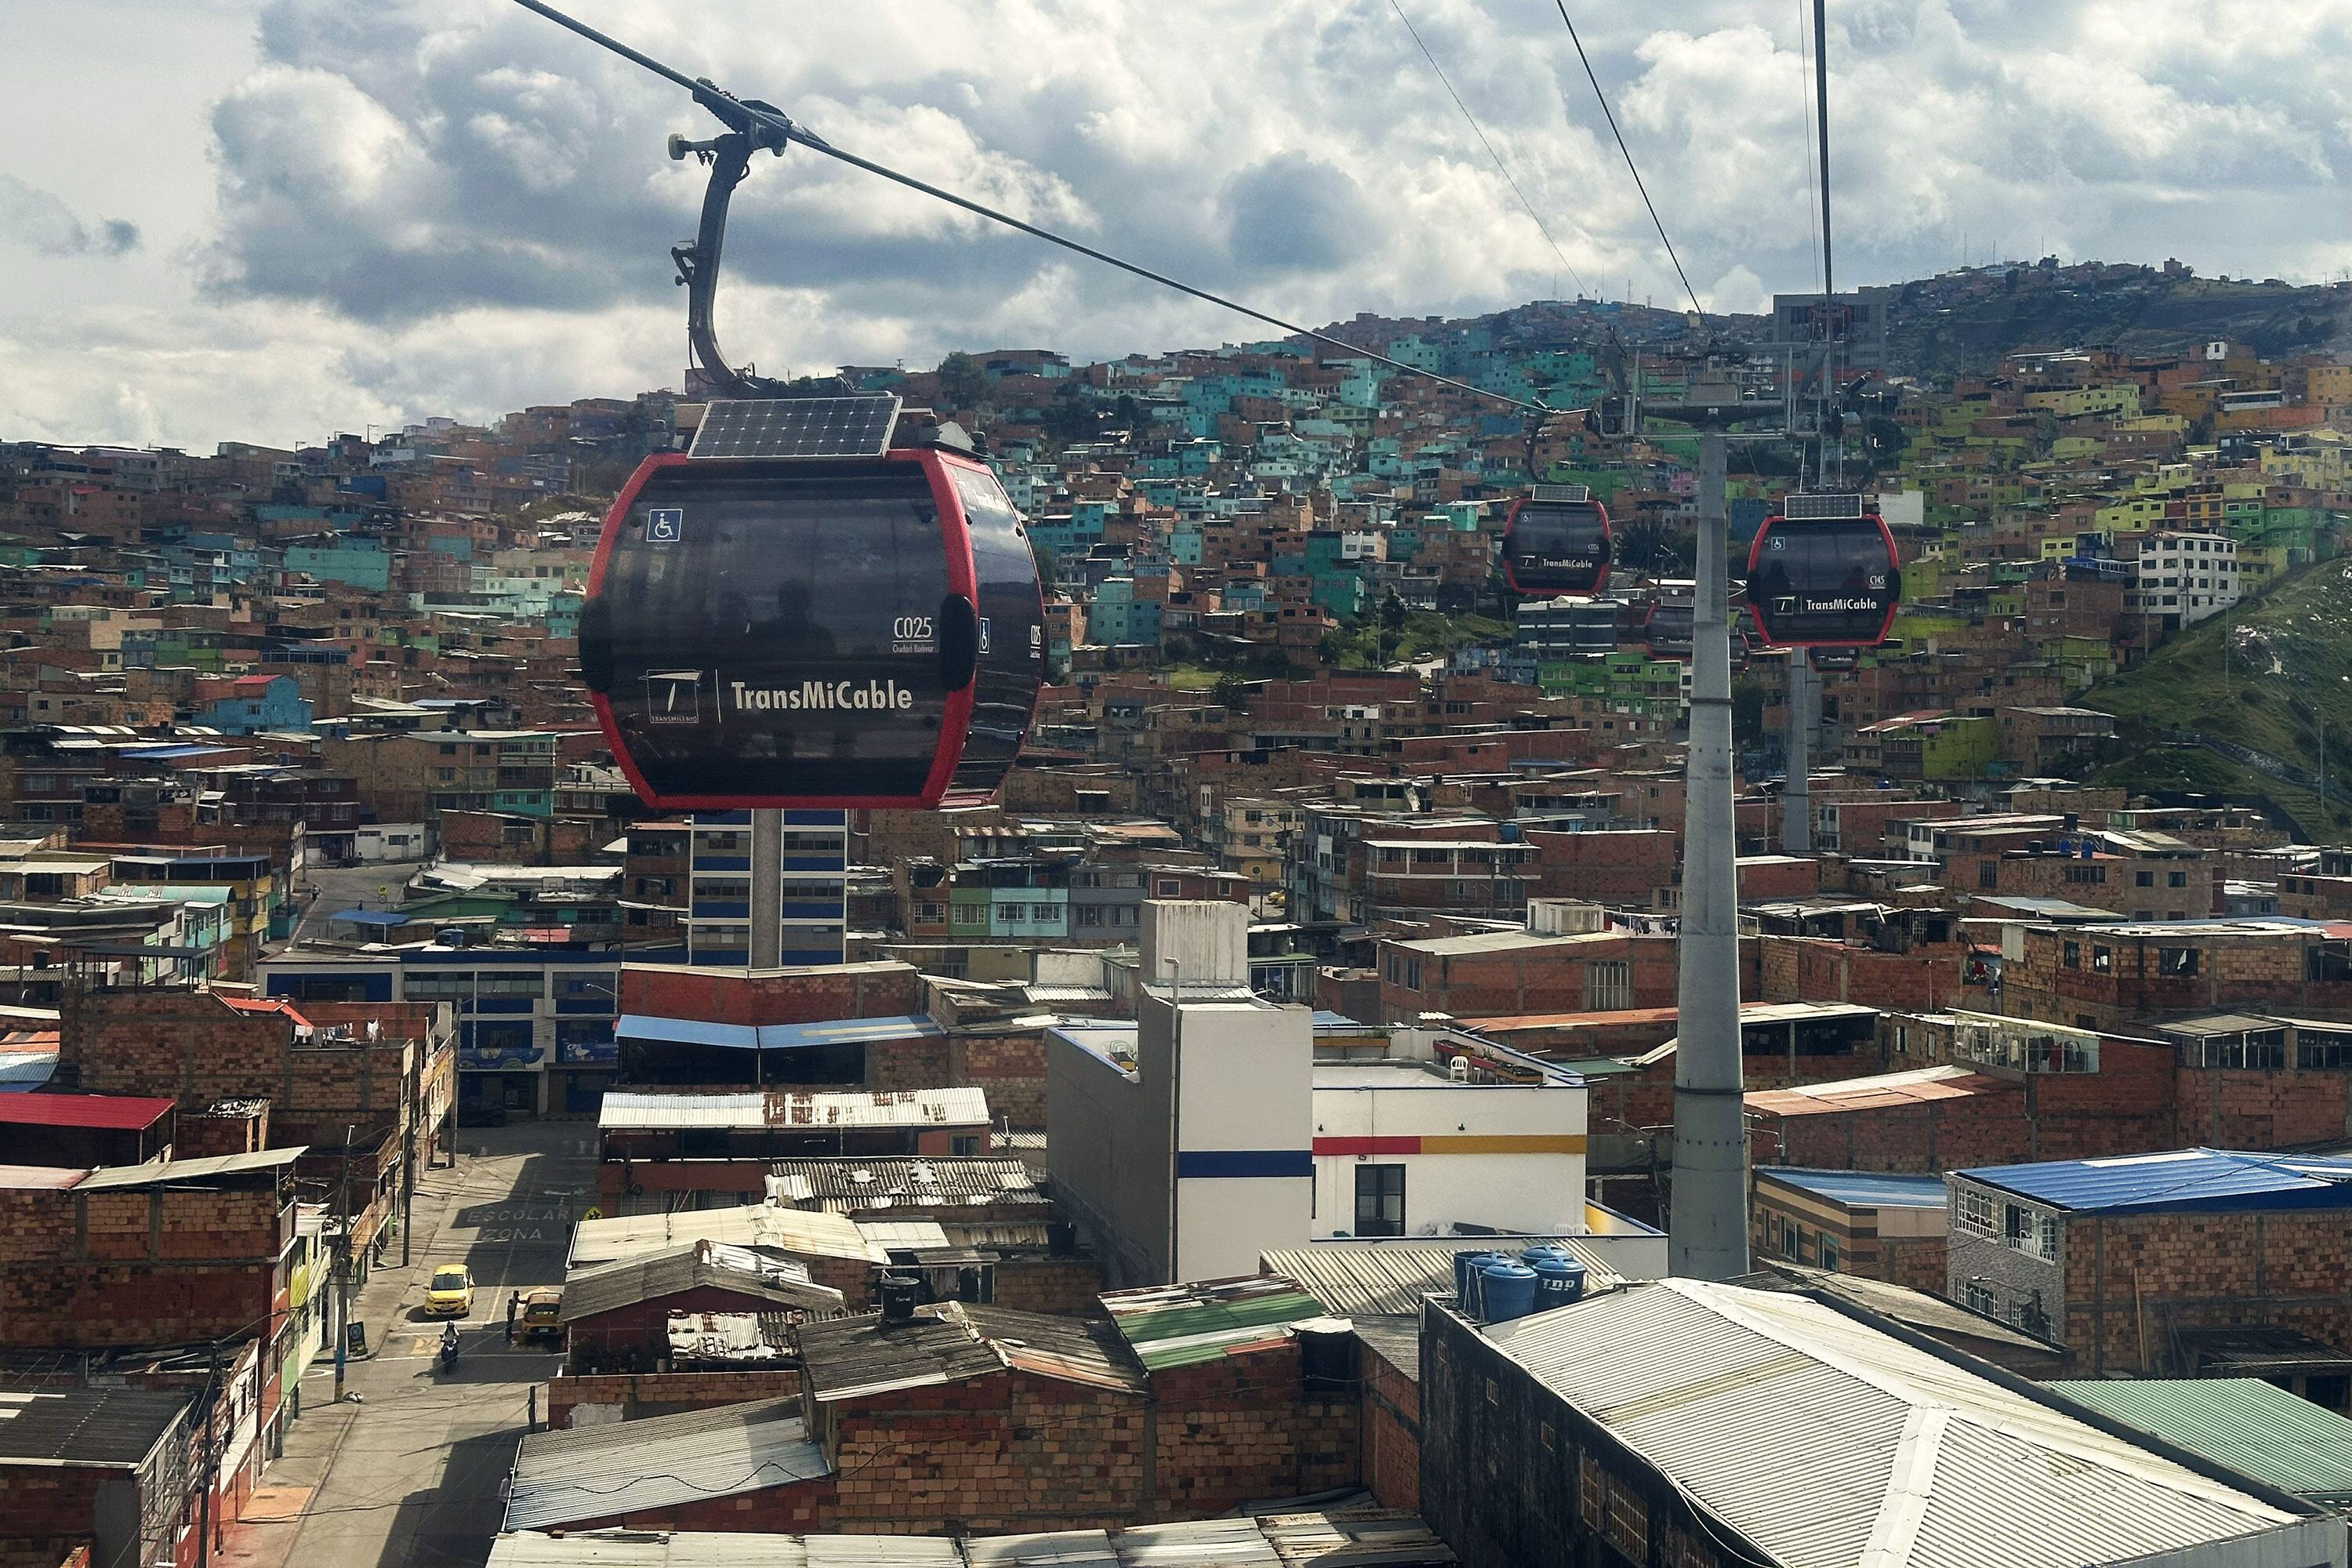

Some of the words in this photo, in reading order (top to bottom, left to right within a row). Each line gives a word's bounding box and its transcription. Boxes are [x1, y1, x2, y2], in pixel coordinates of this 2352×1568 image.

[1543, 558, 1592, 568] TransMiCable
[1806, 597, 1877, 611] TransMiCable
[894, 617, 932, 639] C025
[731, 679, 913, 710] TransMiCable
[467, 1210, 568, 1222] ESCOLAR
[482, 1228, 542, 1240] ZONA
